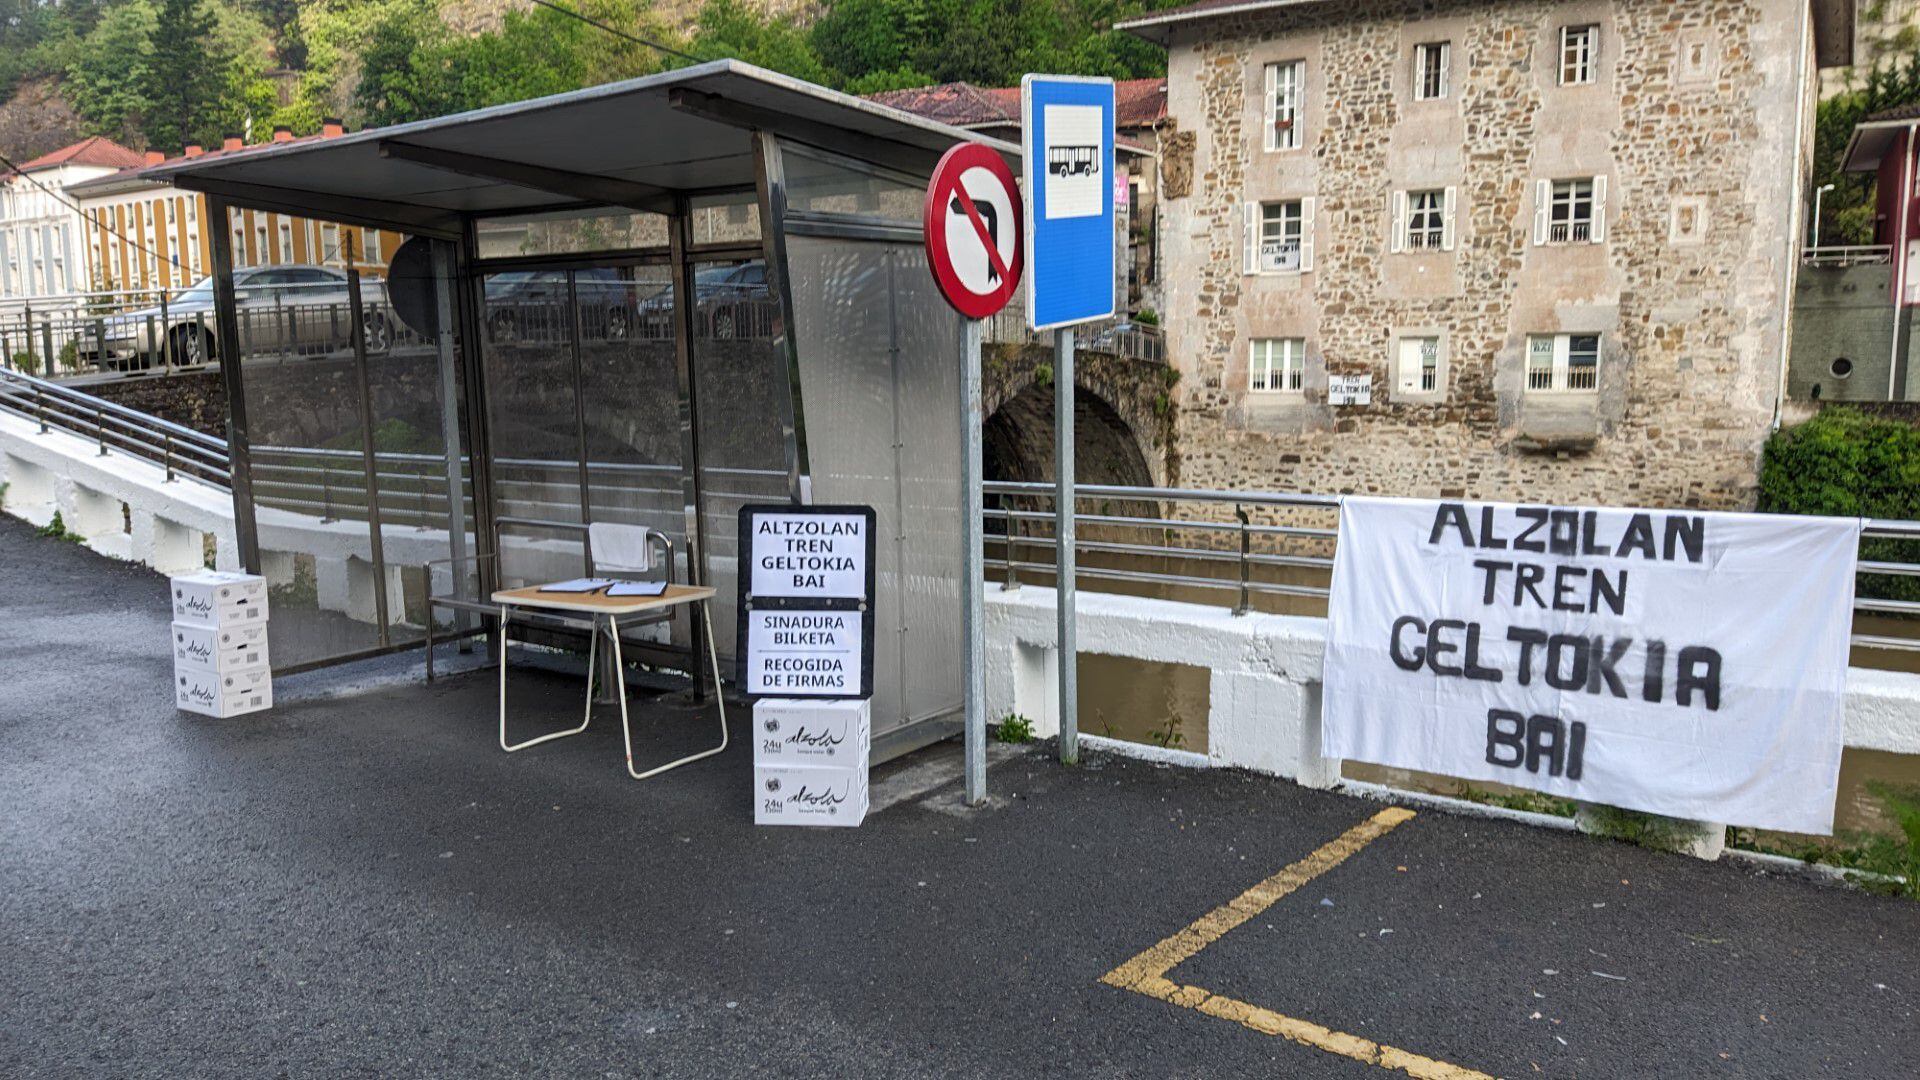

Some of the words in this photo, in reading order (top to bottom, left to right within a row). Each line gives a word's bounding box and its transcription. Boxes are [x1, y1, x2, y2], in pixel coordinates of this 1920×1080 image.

[759, 521, 859, 535] ALTZOLAN
[1429, 503, 1705, 563] ALZOLAN
[784, 538, 833, 553] TREN
[761, 556, 855, 571] GELTOKIA
[793, 574, 825, 588] BAI
[1473, 560, 1628, 616] TREN
[764, 616, 844, 629] SINADURA
[774, 632, 835, 645] BILKETA
[764, 658, 843, 672] RECOGIDA
[1390, 615, 1723, 711] GELTOKIA
[763, 674, 782, 687] DE
[787, 674, 844, 687] FIRMAS
[1485, 708, 1587, 781] BAI
